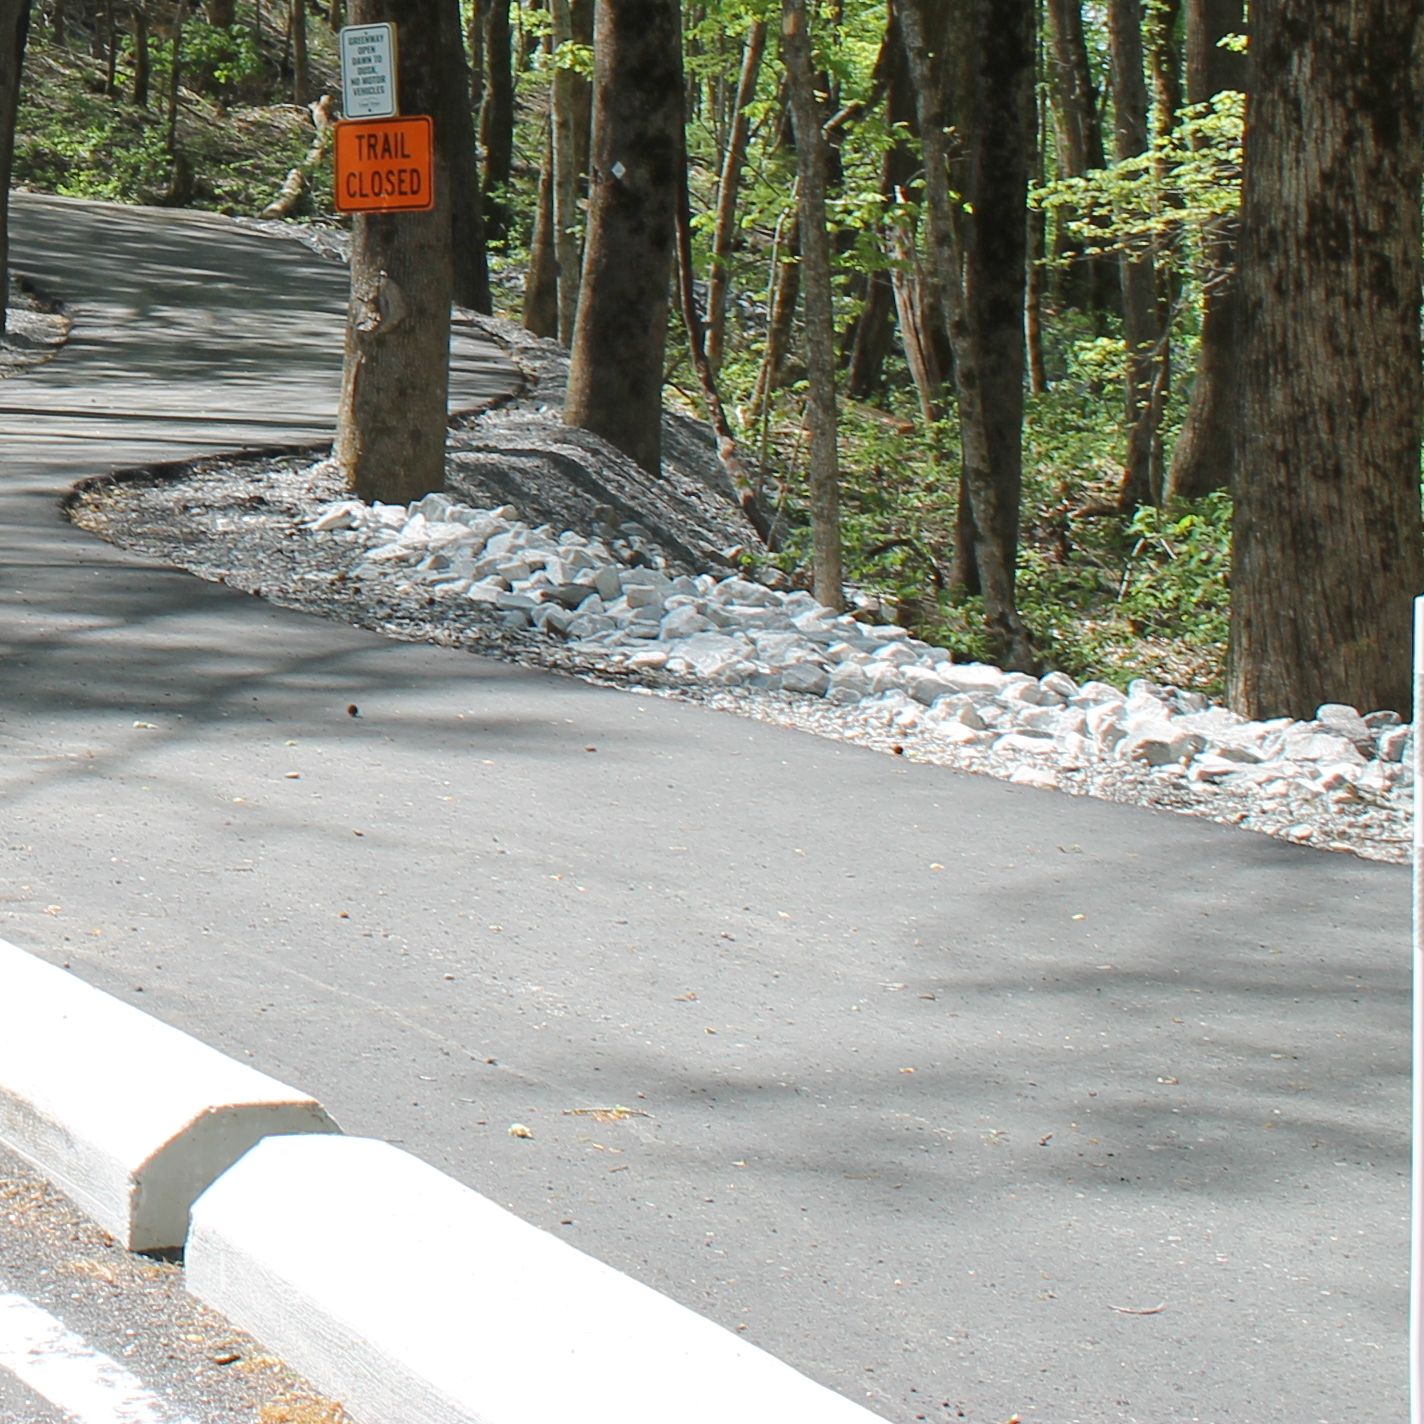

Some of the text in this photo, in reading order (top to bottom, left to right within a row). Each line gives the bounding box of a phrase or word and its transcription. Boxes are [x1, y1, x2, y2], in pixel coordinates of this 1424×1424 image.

[358, 46, 375, 55] OPEN
[374, 55, 383, 63] TO
[351, 77, 360, 85] NO
[353, 86, 385, 96] VEHICLES
[355, 132, 411, 160] TRAIL
[347, 168, 421, 198] CLOSED
